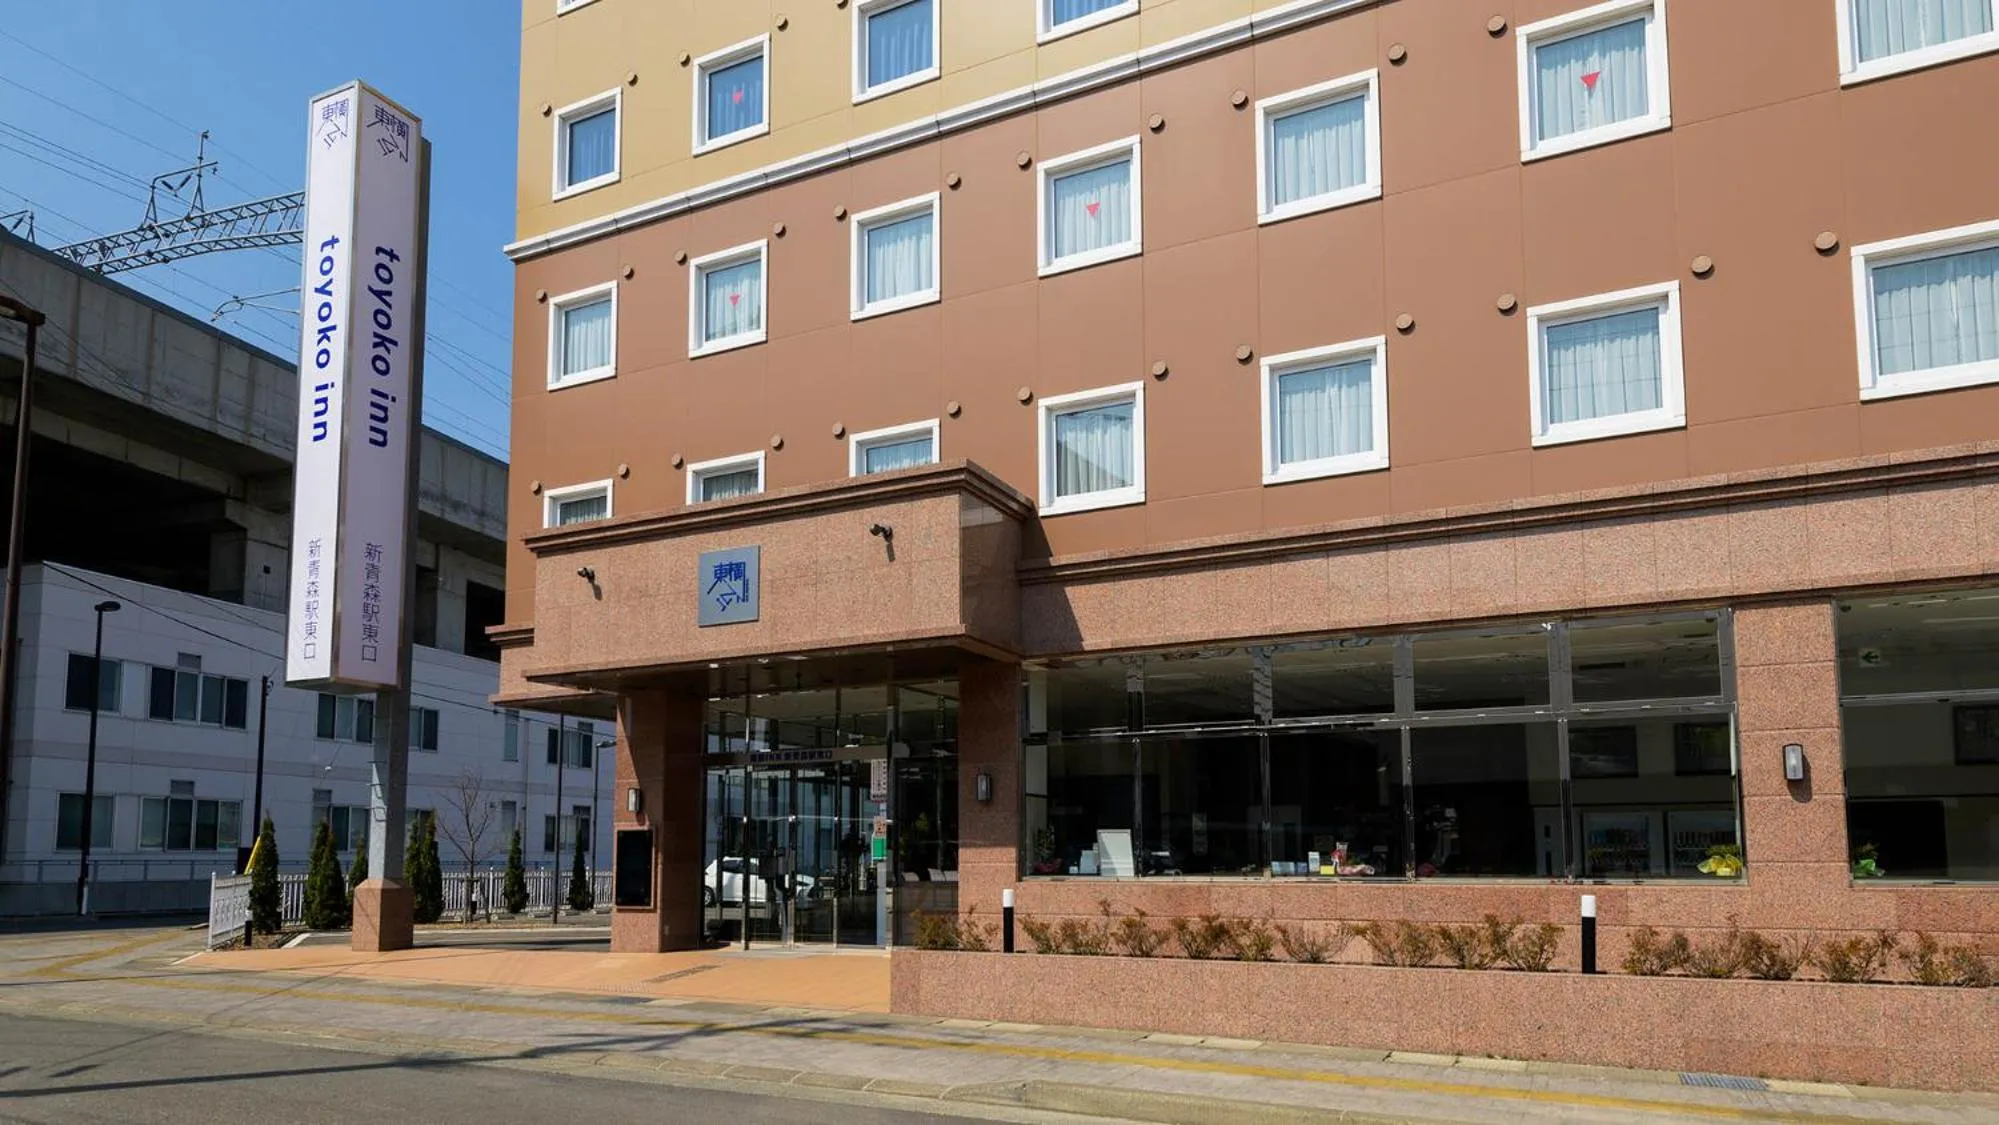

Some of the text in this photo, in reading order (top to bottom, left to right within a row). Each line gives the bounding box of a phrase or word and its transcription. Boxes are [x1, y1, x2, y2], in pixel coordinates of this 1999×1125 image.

[313, 234, 341, 443] toyoko inn
[368, 245, 401, 449] toyoko inn
[303, 538, 322, 660] 新青森駅東口
[361, 543, 384, 663] 新青森駅東口
